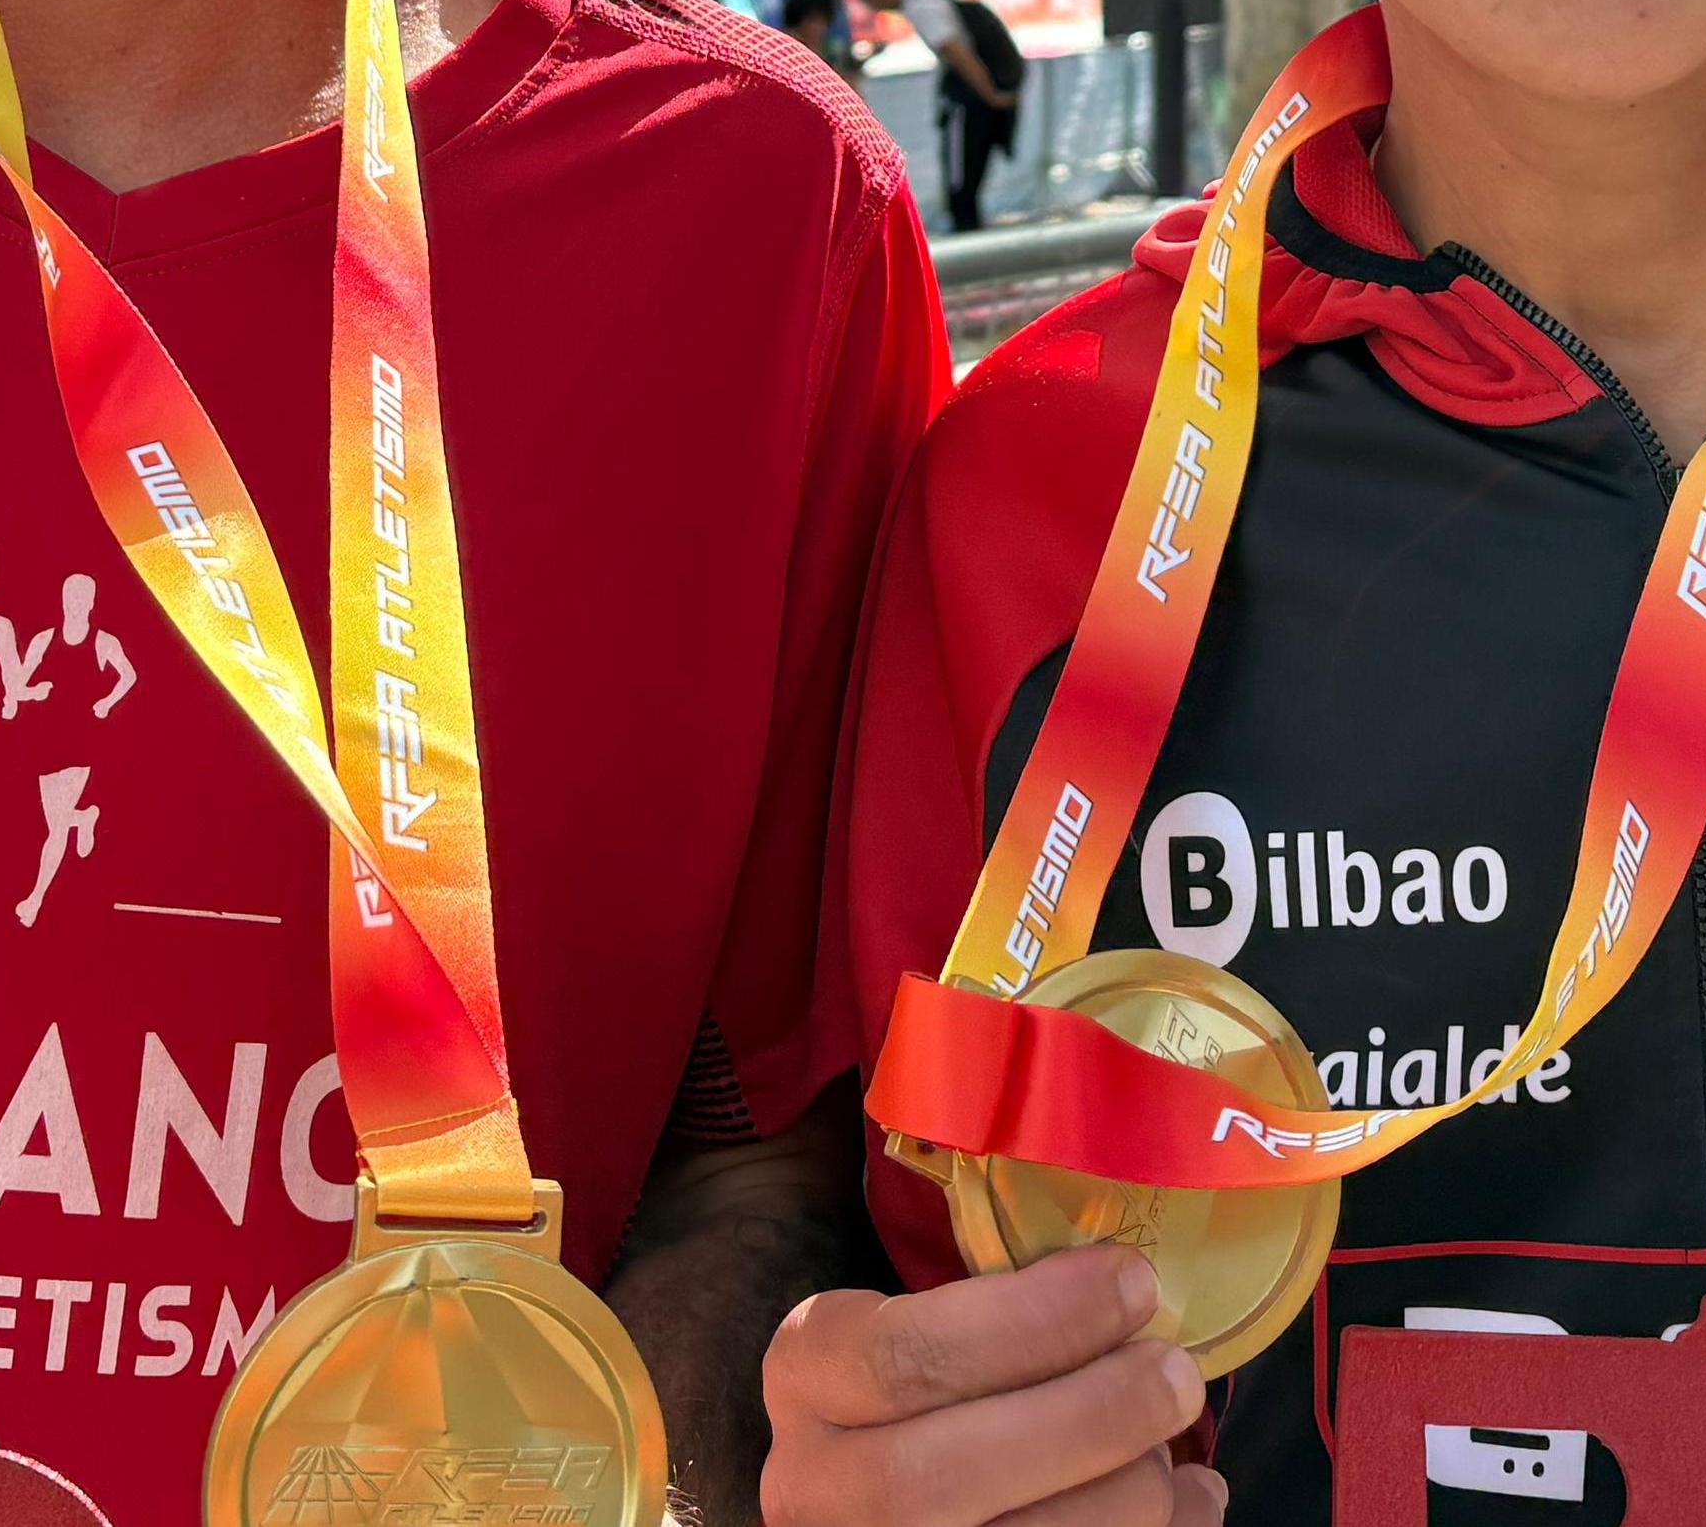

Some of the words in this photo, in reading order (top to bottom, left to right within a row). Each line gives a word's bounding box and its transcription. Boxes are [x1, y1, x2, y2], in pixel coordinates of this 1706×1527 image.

[1137, 421, 1213, 604] RFEA
[1195, 91, 1311, 410] ATLETISMO
[372, 353, 417, 658] ATLETISMO
[376, 667, 440, 852] RFEA
[990, 780, 1094, 997] LETISMO
[1165, 827, 1509, 931] Bilbao
[1311, 1024, 1573, 1105] aialde
